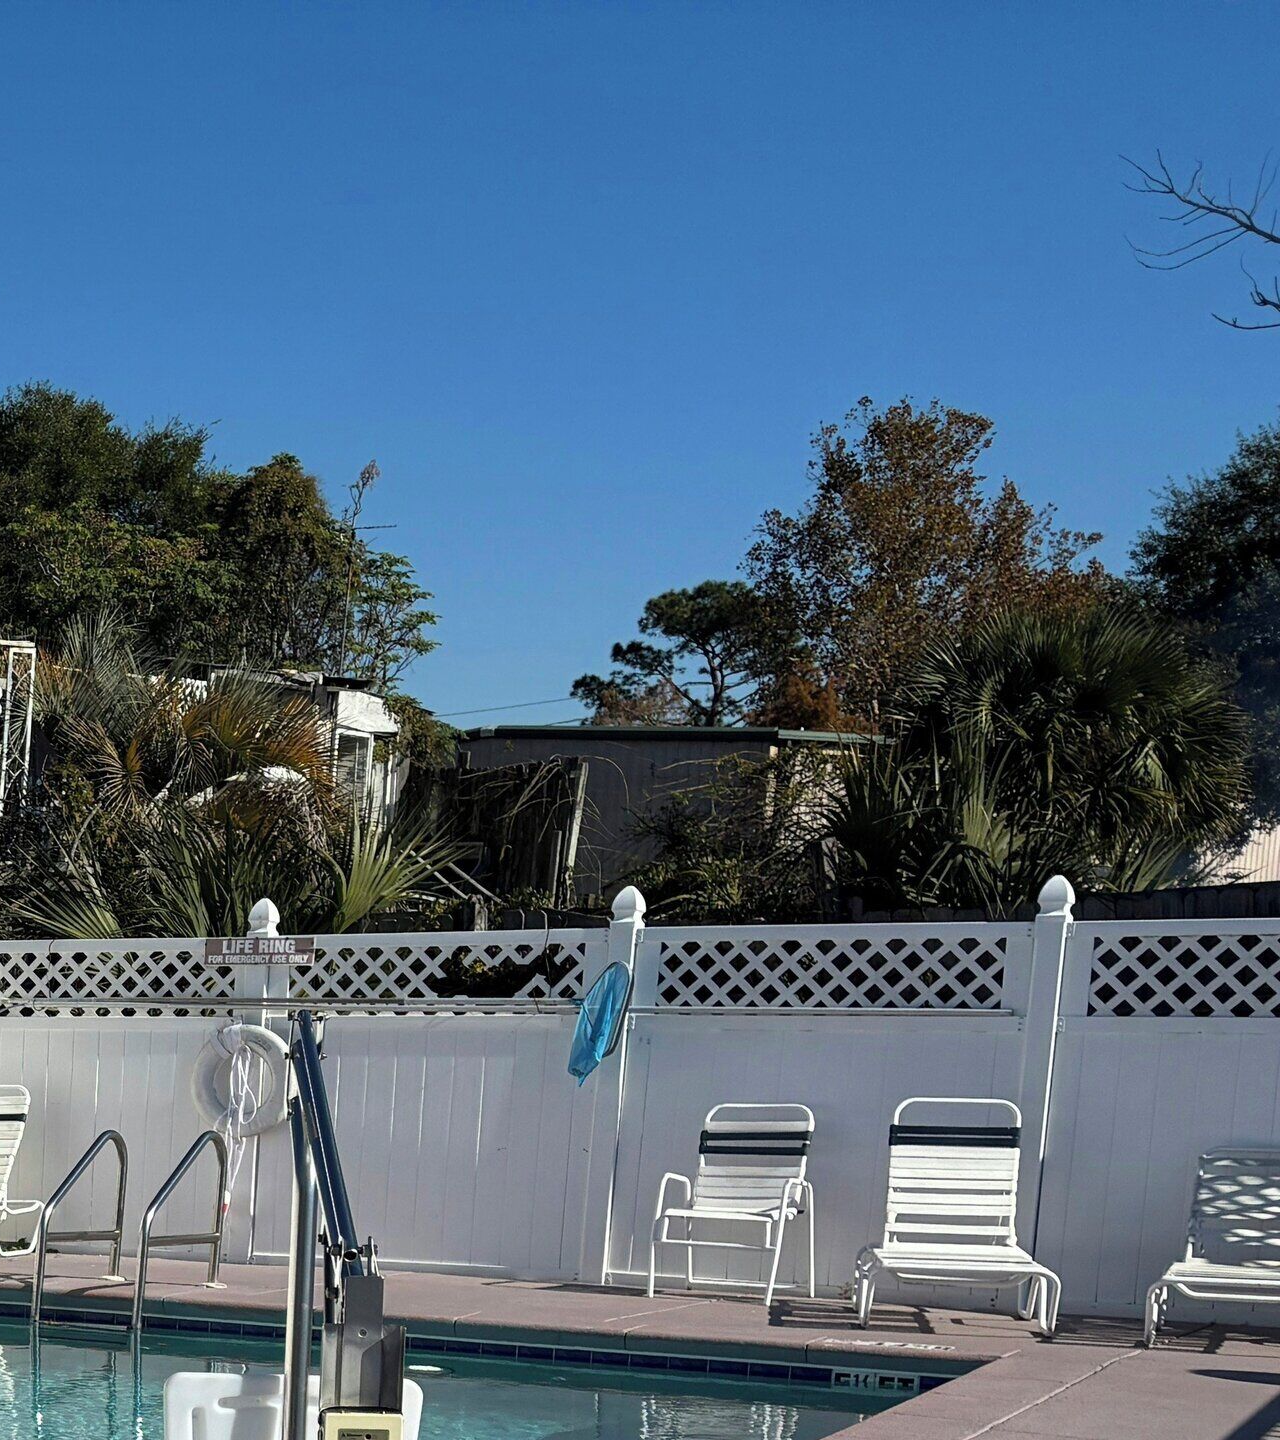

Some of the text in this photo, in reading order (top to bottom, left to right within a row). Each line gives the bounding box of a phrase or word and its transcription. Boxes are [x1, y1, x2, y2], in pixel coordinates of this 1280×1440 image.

[222, 940, 296, 954] LIFE RING
[225, 955, 270, 963] EMERGENCY
[272, 955, 287, 963] USE
[289, 955, 309, 963] ONLY
